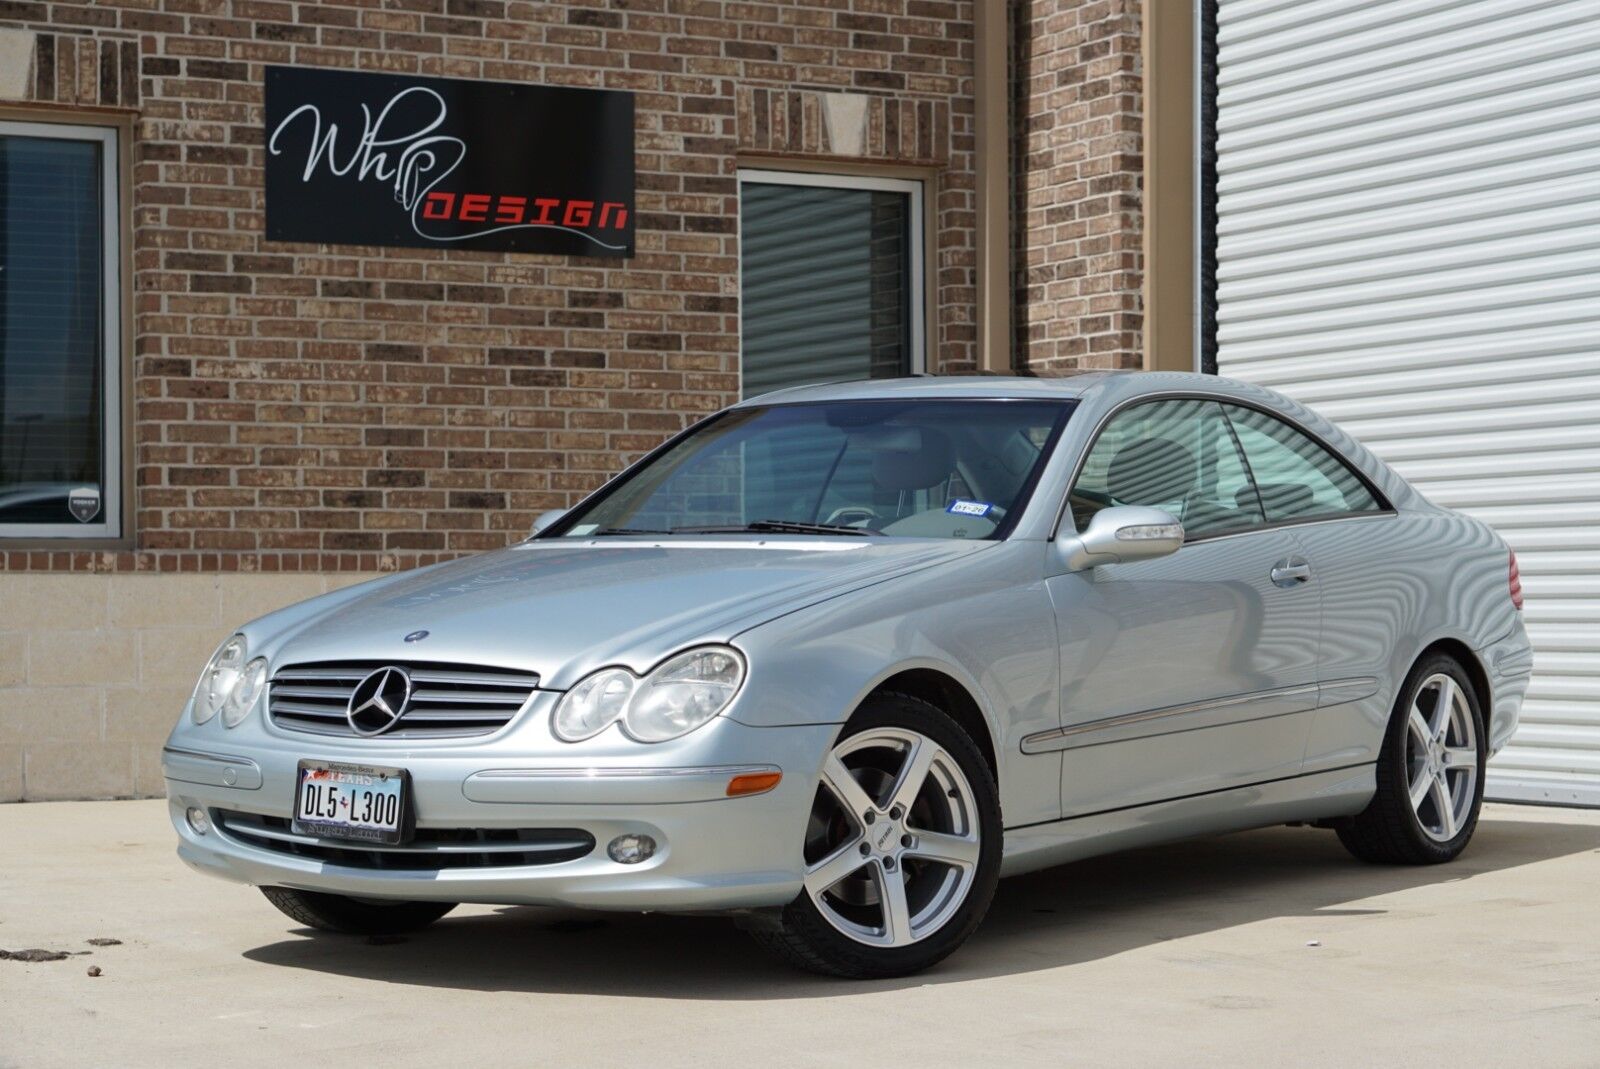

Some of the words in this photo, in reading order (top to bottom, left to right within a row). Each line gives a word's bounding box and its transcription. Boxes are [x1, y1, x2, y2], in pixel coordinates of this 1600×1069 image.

[269, 86, 466, 211] Whip
[422, 191, 628, 230] DESIGN
[330, 770, 373, 786] TEXAS
[305, 784, 338, 818] DL5
[350, 788, 397, 826] L300
